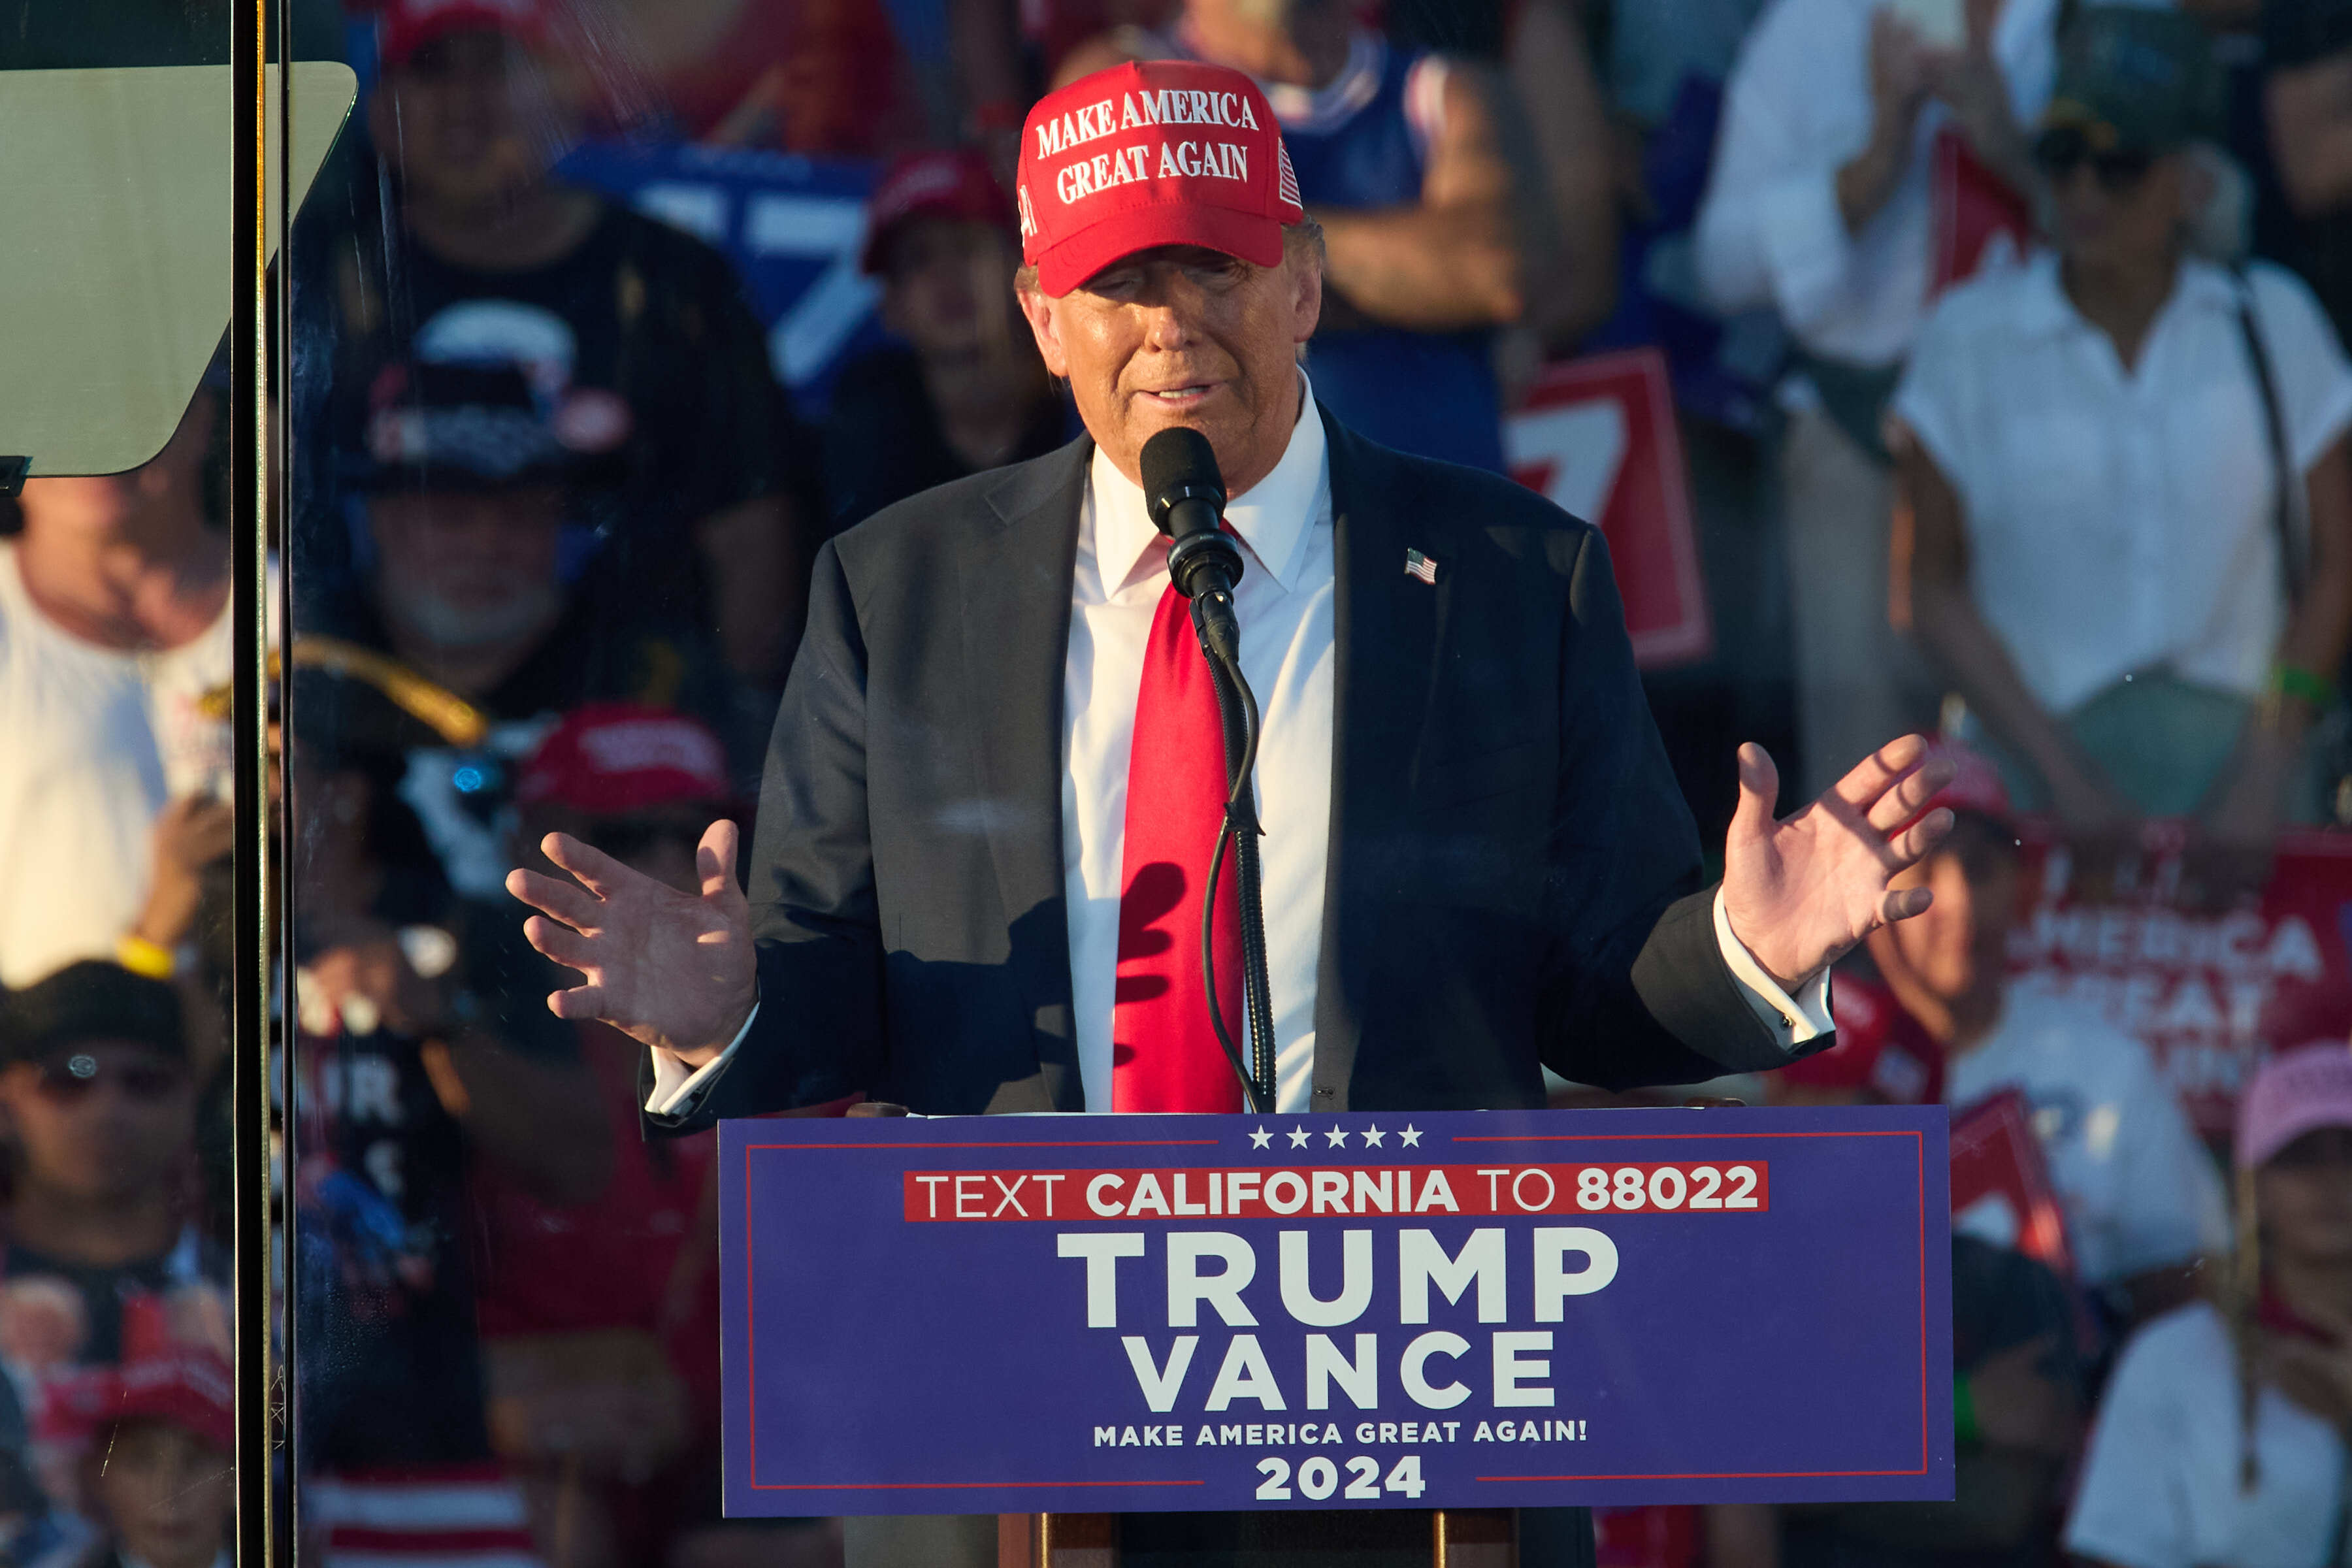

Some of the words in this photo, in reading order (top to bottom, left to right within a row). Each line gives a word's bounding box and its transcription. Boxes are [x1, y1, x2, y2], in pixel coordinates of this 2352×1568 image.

[1036, 99, 1117, 160] MAKE
[1120, 90, 1260, 131] AMERICA
[1056, 144, 1149, 205] GREAT
[1158, 141, 1248, 183] AGAIN
[916, 1175, 1065, 1217] TEXT
[1086, 1170, 1460, 1217] CALIFORNIA
[1477, 1168, 1555, 1212] TO
[1576, 1166, 1759, 1211] 88022
[1057, 1227, 1619, 1328] TRUMP
[1121, 1330, 1555, 1413] VANCE
[1094, 1426, 1183, 1447] MAKE
[1196, 1423, 1343, 1446] AMERICA
[1356, 1421, 1461, 1444] GREAT
[1473, 1420, 1586, 1442] AGAIN!
[1256, 1456, 1426, 1500] 2024
